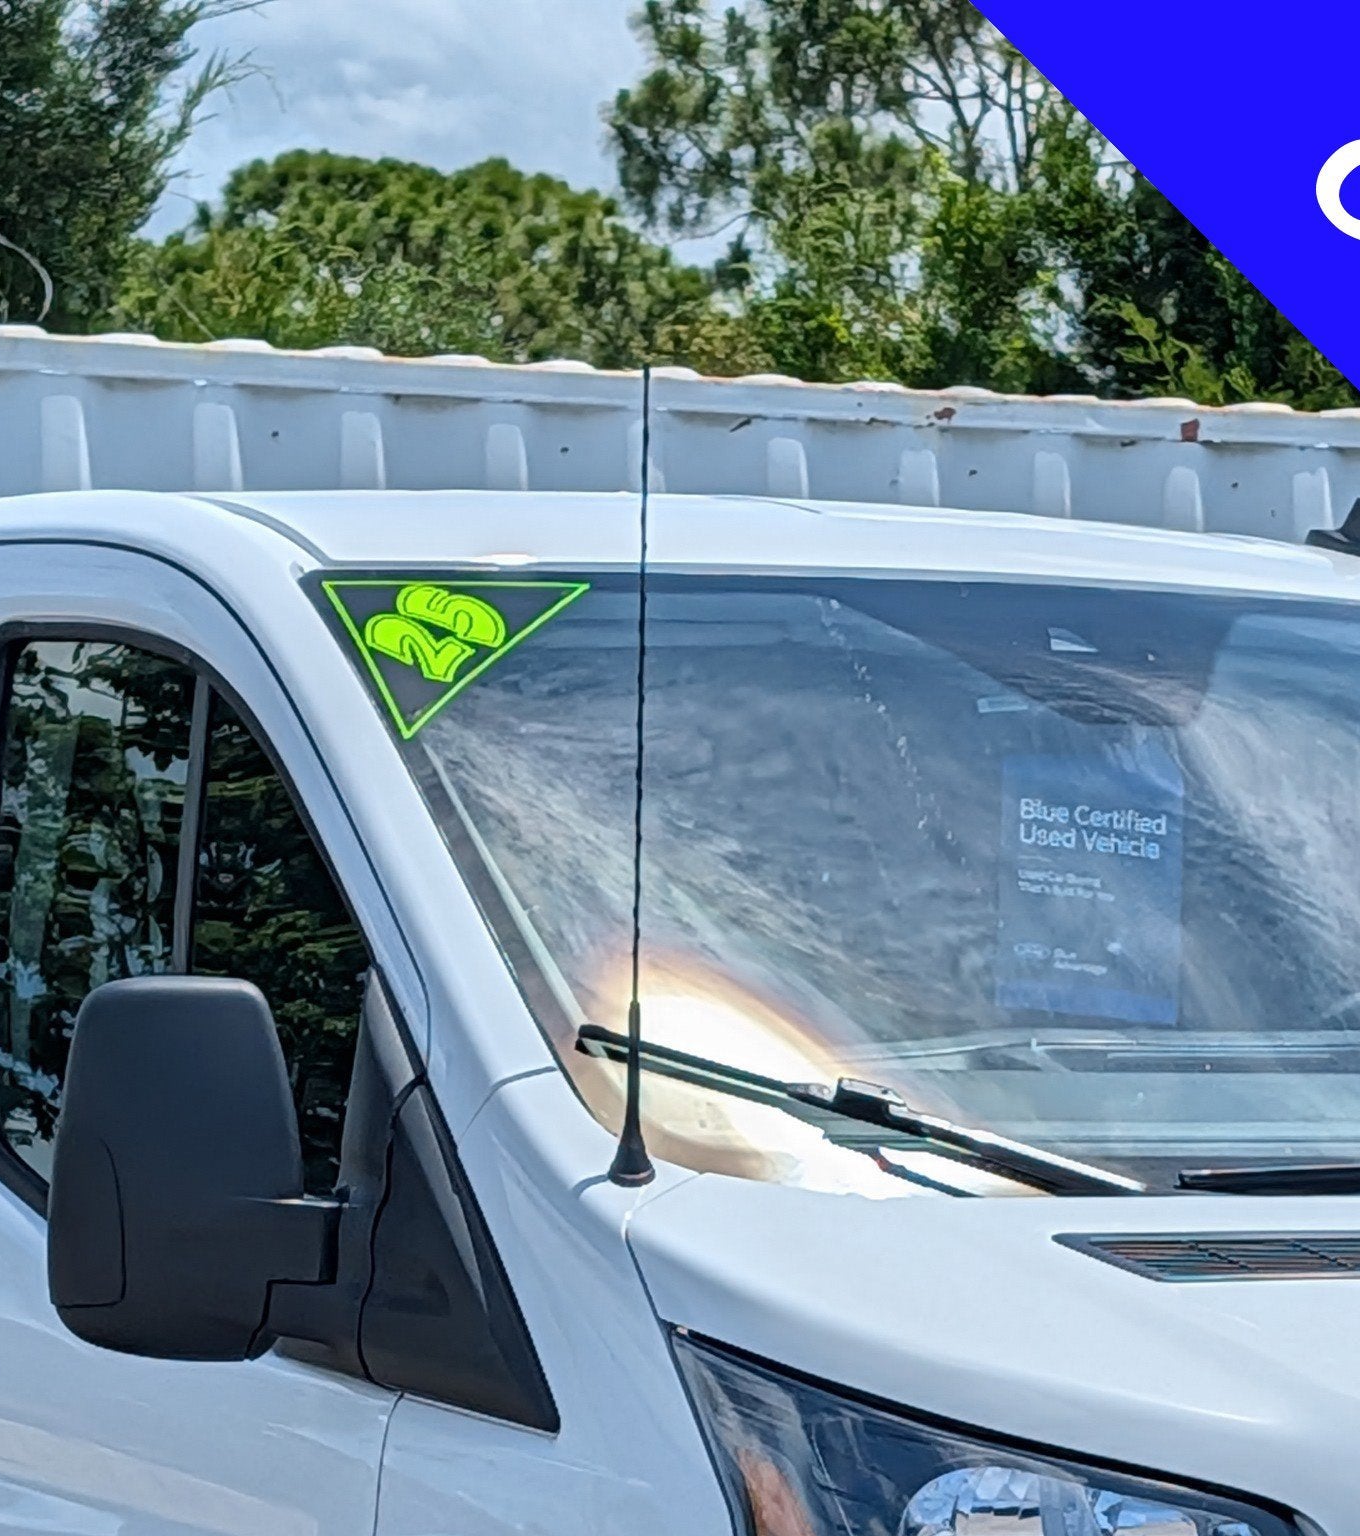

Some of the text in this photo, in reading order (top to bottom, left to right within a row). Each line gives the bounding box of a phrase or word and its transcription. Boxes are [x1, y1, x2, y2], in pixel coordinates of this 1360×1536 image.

[364, 583, 507, 683] 25
[1019, 798, 1168, 836] Blue Certified
[1019, 822, 1161, 860] Used Vehicle
